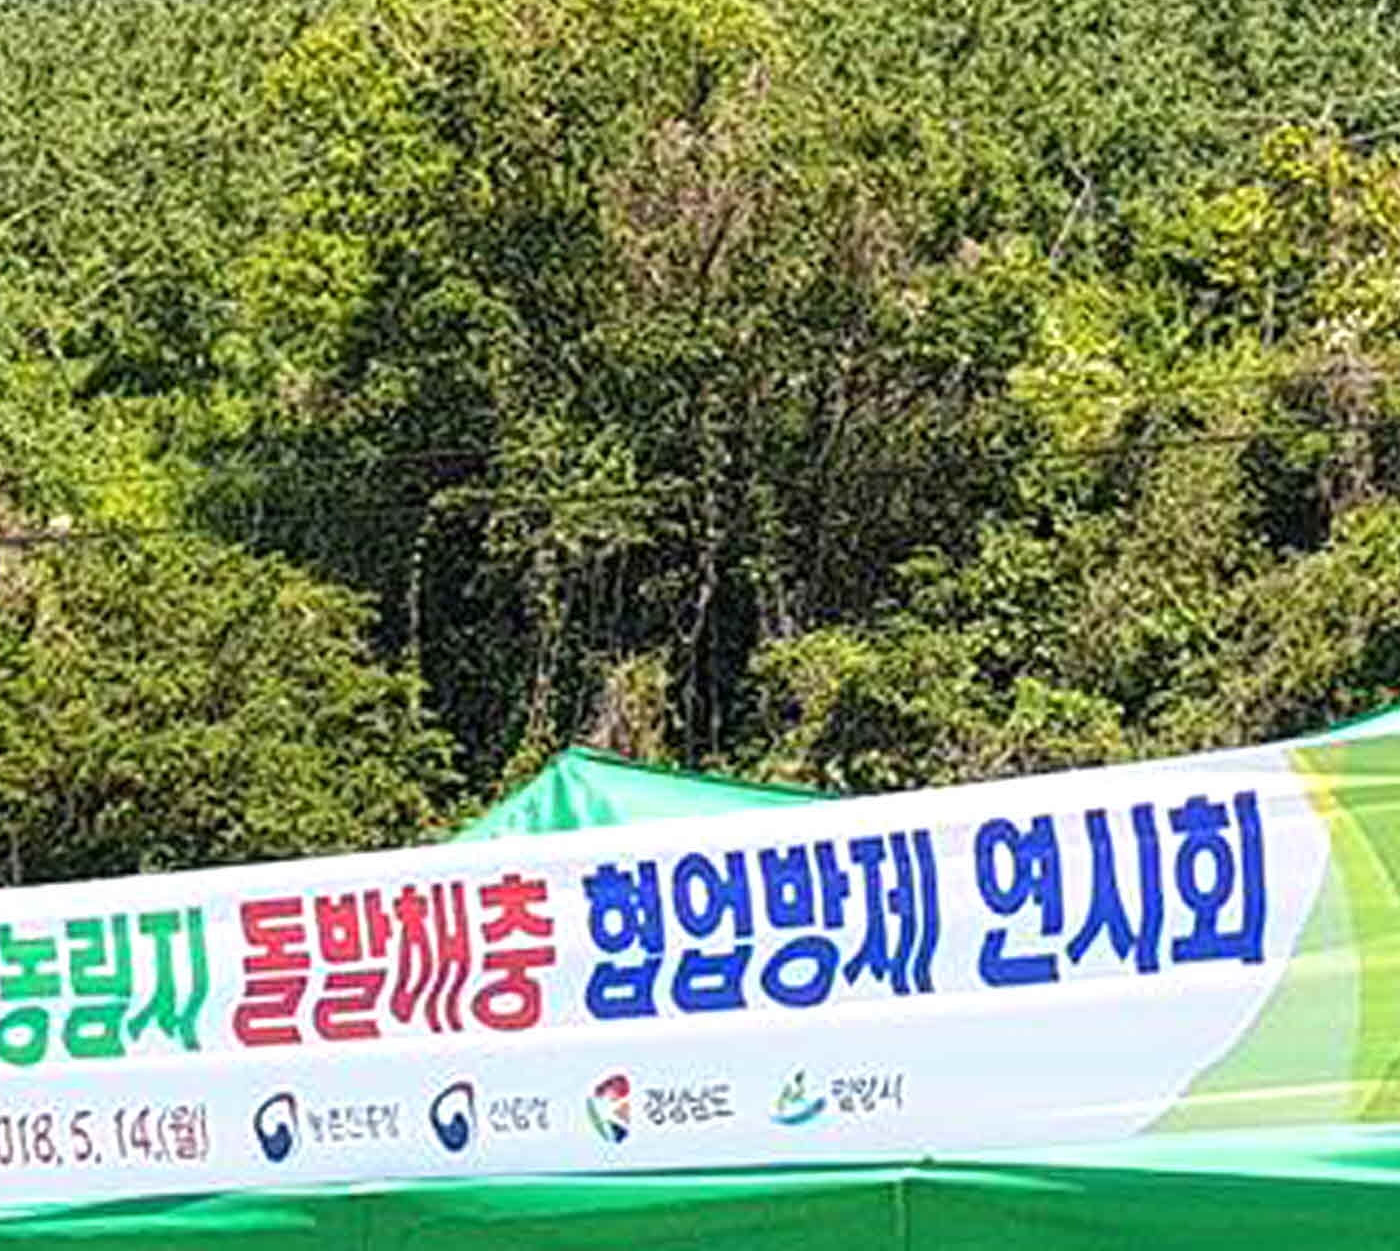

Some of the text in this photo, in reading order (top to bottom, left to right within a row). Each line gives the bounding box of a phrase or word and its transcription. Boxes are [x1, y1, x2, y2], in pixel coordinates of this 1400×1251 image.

[232, 873, 555, 1047] 돌발해충
[581, 829, 940, 1020] 협업방제
[974, 789, 1266, 988] 연시회
